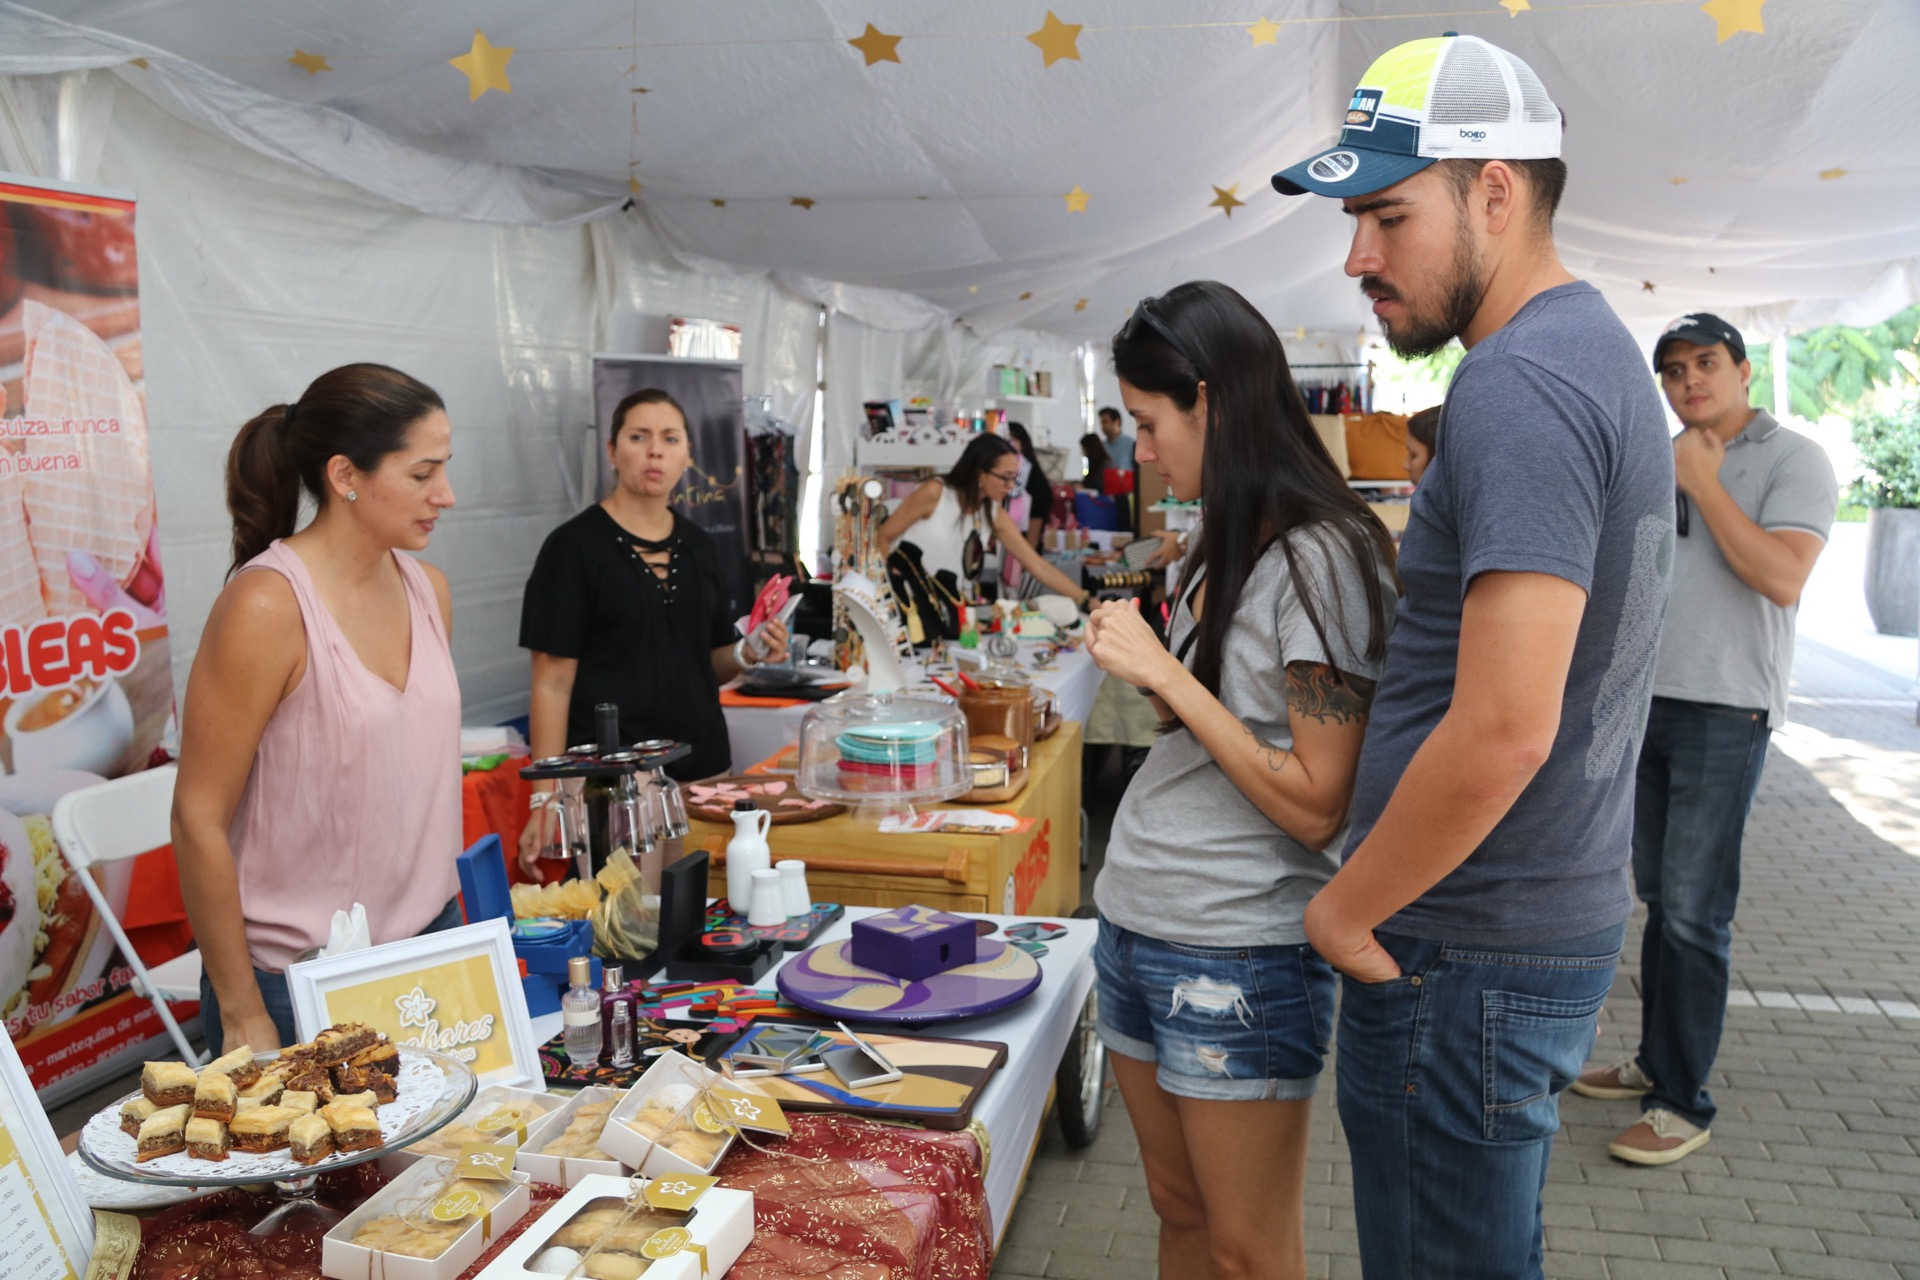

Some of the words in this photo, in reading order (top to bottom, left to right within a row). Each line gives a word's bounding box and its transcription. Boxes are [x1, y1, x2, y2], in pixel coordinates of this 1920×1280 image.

[0, 610, 137, 694] LEAS
[26, 1004, 50, 1025] tu
[54, 976, 106, 1015] sabor
